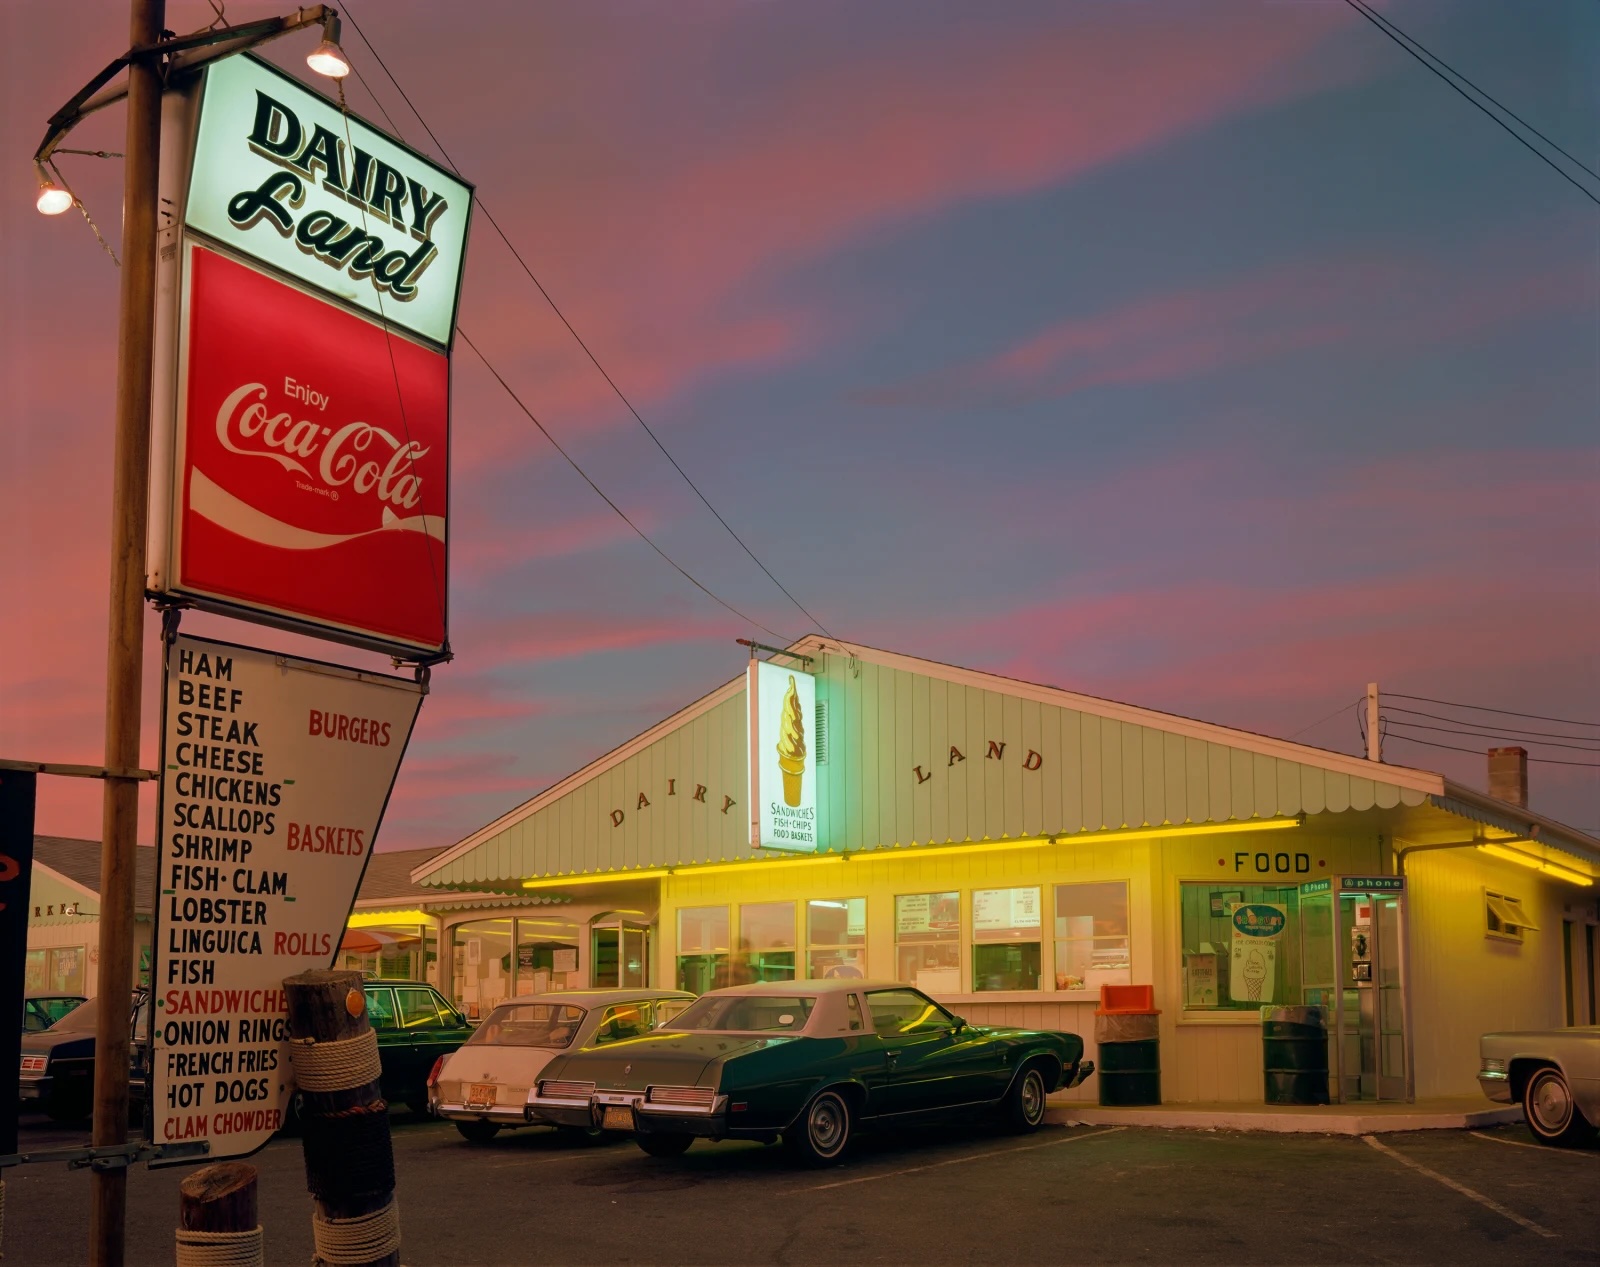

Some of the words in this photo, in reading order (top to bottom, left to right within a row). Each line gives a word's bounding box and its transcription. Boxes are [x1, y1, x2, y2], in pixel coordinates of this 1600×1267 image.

[246, 88, 448, 243] DAIRY
[227, 171, 438, 302] Land
[284, 376, 329, 411] Enjoy
[215, 382, 431, 509] Coca-Cola
[295, 480, 330, 497] Trade-mark
[179, 649, 233, 681] HAM
[178, 680, 243, 713] BEEF
[176, 711, 260, 746] STEAK
[308, 709, 392, 747] BURGERS
[175, 742, 264, 775] CHEESE
[912, 740, 1044, 785] LAND
[175, 772, 282, 807] CHICKENS
[609, 778, 737, 828] DAIRY
[771, 802, 814, 820] SANDWICHES
[173, 803, 276, 835] SCALLOPS
[286, 822, 365, 856] BASKETS
[773, 829, 790, 839] FOOD
[790, 831, 813, 842] BASKETS
[171, 833, 253, 863] SHRIMP
[1234, 852, 1311, 874] FOOD
[232, 869, 288, 896] CLAM
[1310, 881, 1329, 892] Phone
[1357, 879, 1400, 888] phone
[34, 901, 80, 918] RKET
[170, 896, 267, 925] LOBSTER
[168, 928, 263, 955] LINGUICA
[273, 931, 331, 956] ROLLS
[167, 959, 215, 985] FISH
[164, 989, 290, 1015] SANDWICHE
[163, 1020, 230, 1046] ONION
[238, 1018, 292, 1042] RINGS
[167, 1051, 233, 1077] FRENCH
[237, 1049, 278, 1073] FRIES
[167, 1082, 204, 1109] HOT
[214, 1078, 269, 1104] DOGS
[163, 1114, 208, 1141] CLAM
[213, 1108, 281, 1136] CHOWDER
